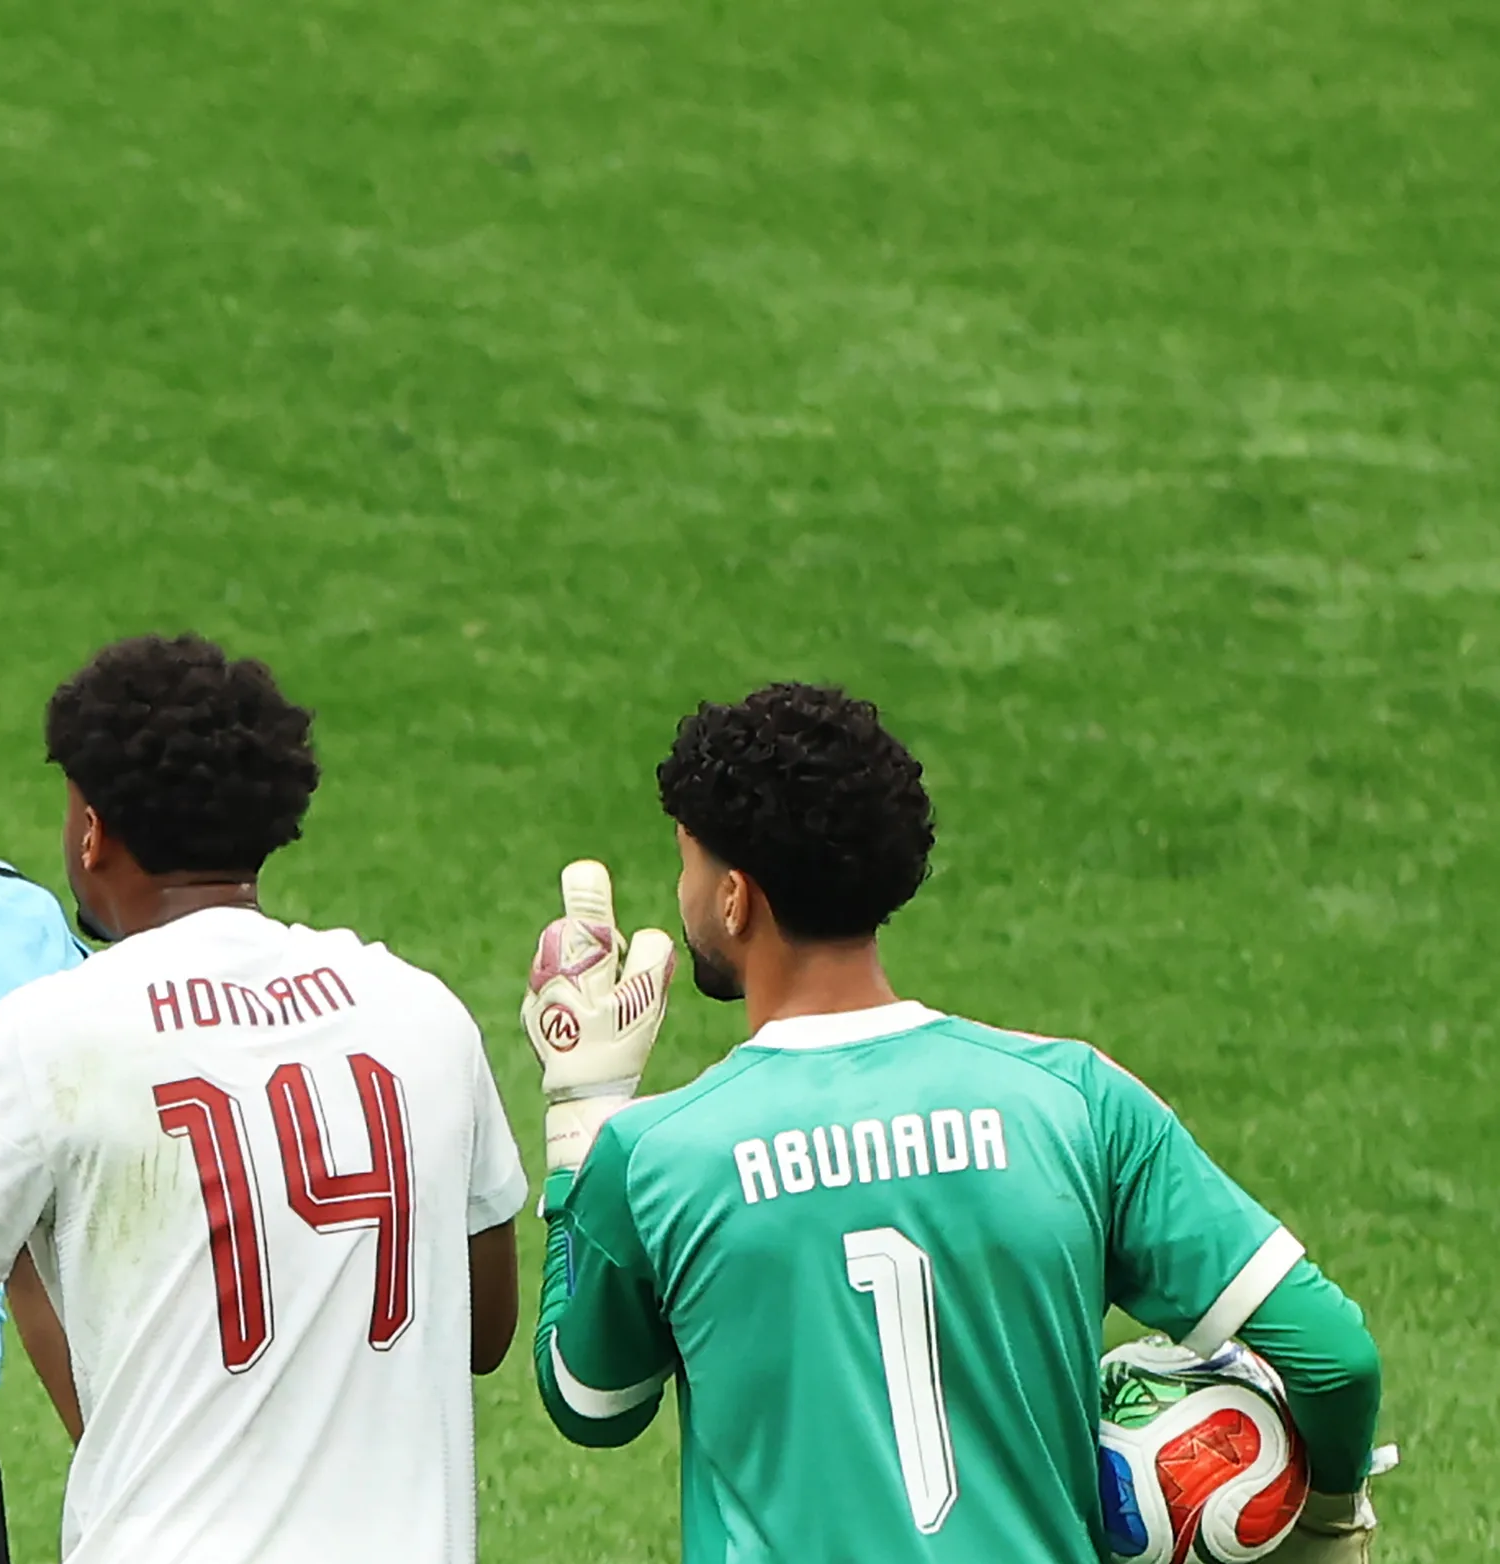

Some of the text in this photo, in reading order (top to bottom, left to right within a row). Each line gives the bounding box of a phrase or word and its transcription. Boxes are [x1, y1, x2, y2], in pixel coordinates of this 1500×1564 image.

[146, 967, 357, 1032] HOMAM
[151, 1053, 417, 1375] 14
[733, 1107, 1008, 1204] ABUNADA
[842, 1226, 959, 1535] 1
